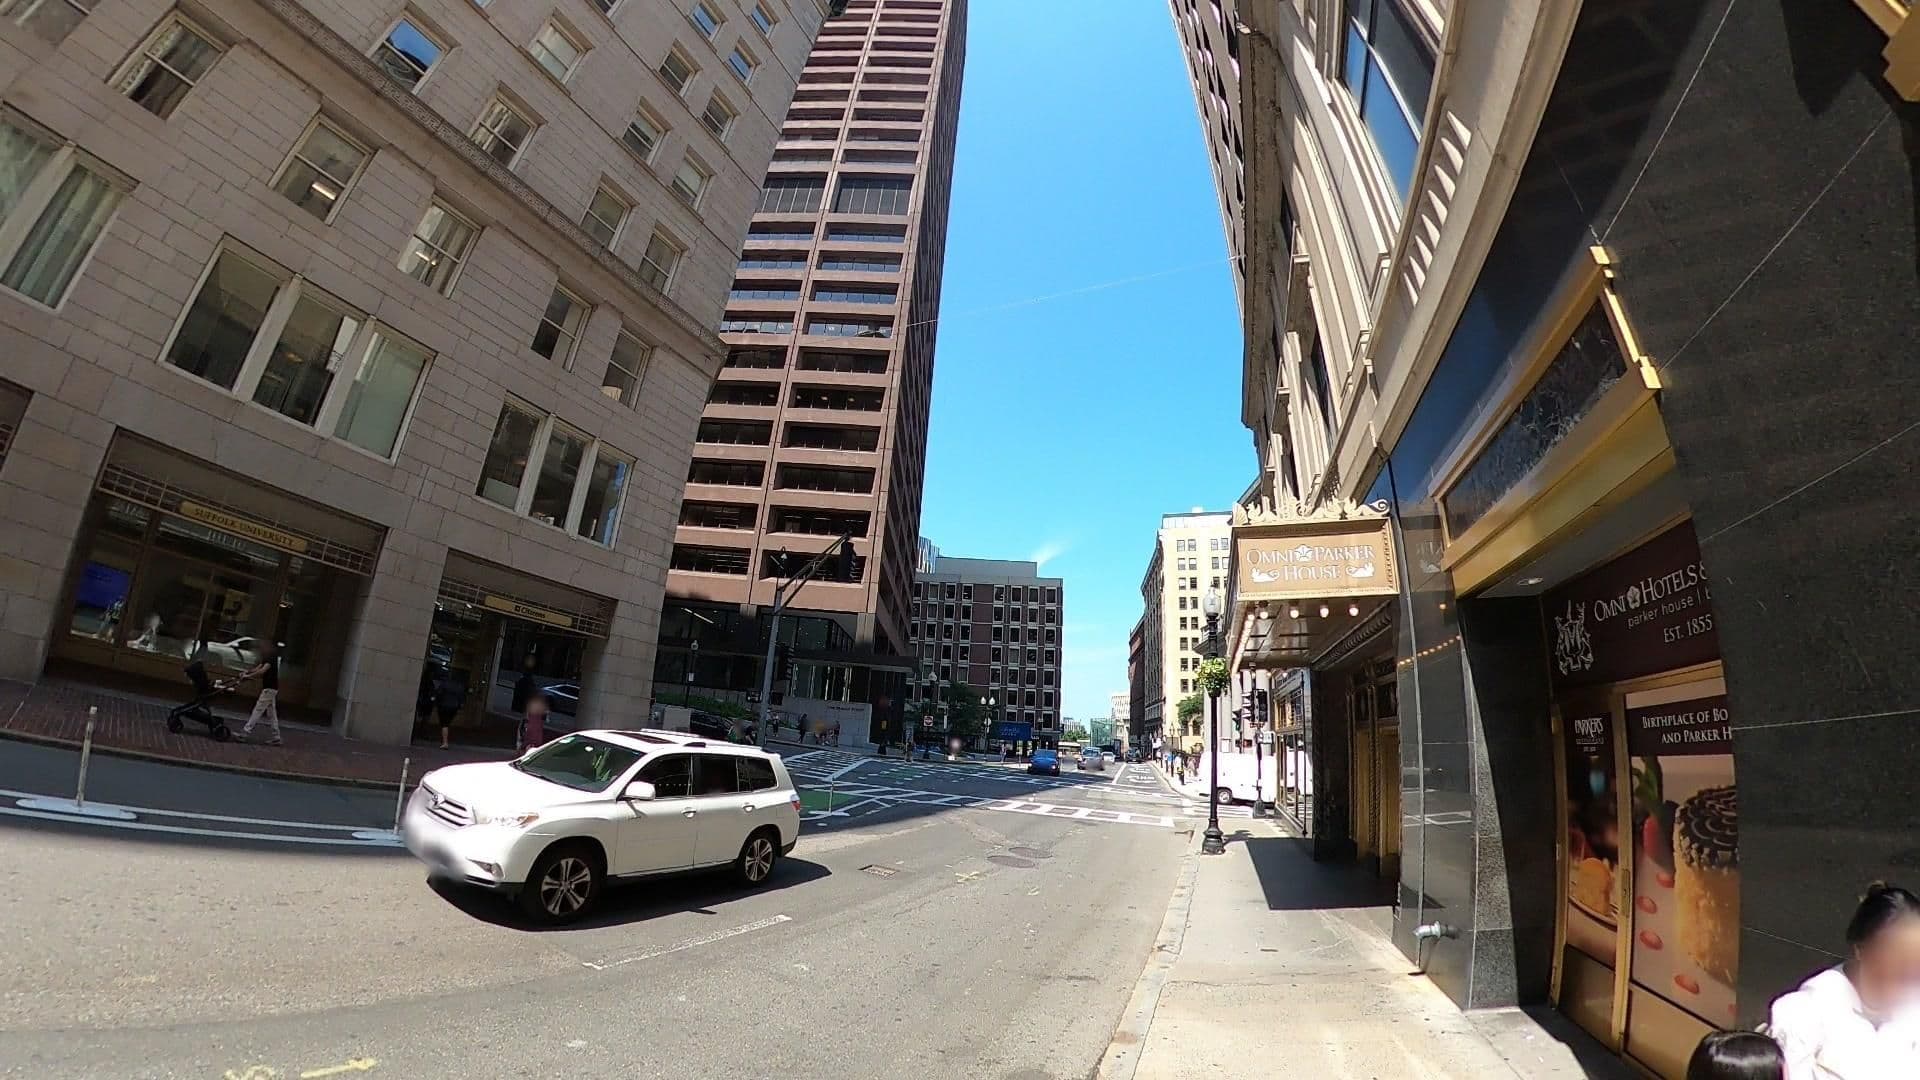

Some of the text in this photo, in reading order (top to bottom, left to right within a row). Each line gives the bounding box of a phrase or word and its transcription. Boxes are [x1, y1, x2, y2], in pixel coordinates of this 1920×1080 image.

[195, 508, 294, 546] SUFFOLK UNIVERSITY
[1247, 545, 1376, 565] OMNI PARKER
[1282, 565, 1341, 580] HOUSE
[1594, 595, 1626, 621] OMNI
[1640, 564, 1698, 604] HOTELS
[1628, 596, 1694, 629] parker house
[1663, 614, 1713, 643] EST. 1855
[1642, 712, 1696, 728] BIRTHPLACE
[1697, 711, 1710, 723] OF
[1662, 732, 1681, 744] AND
[1683, 729, 1720, 743] PARKER
